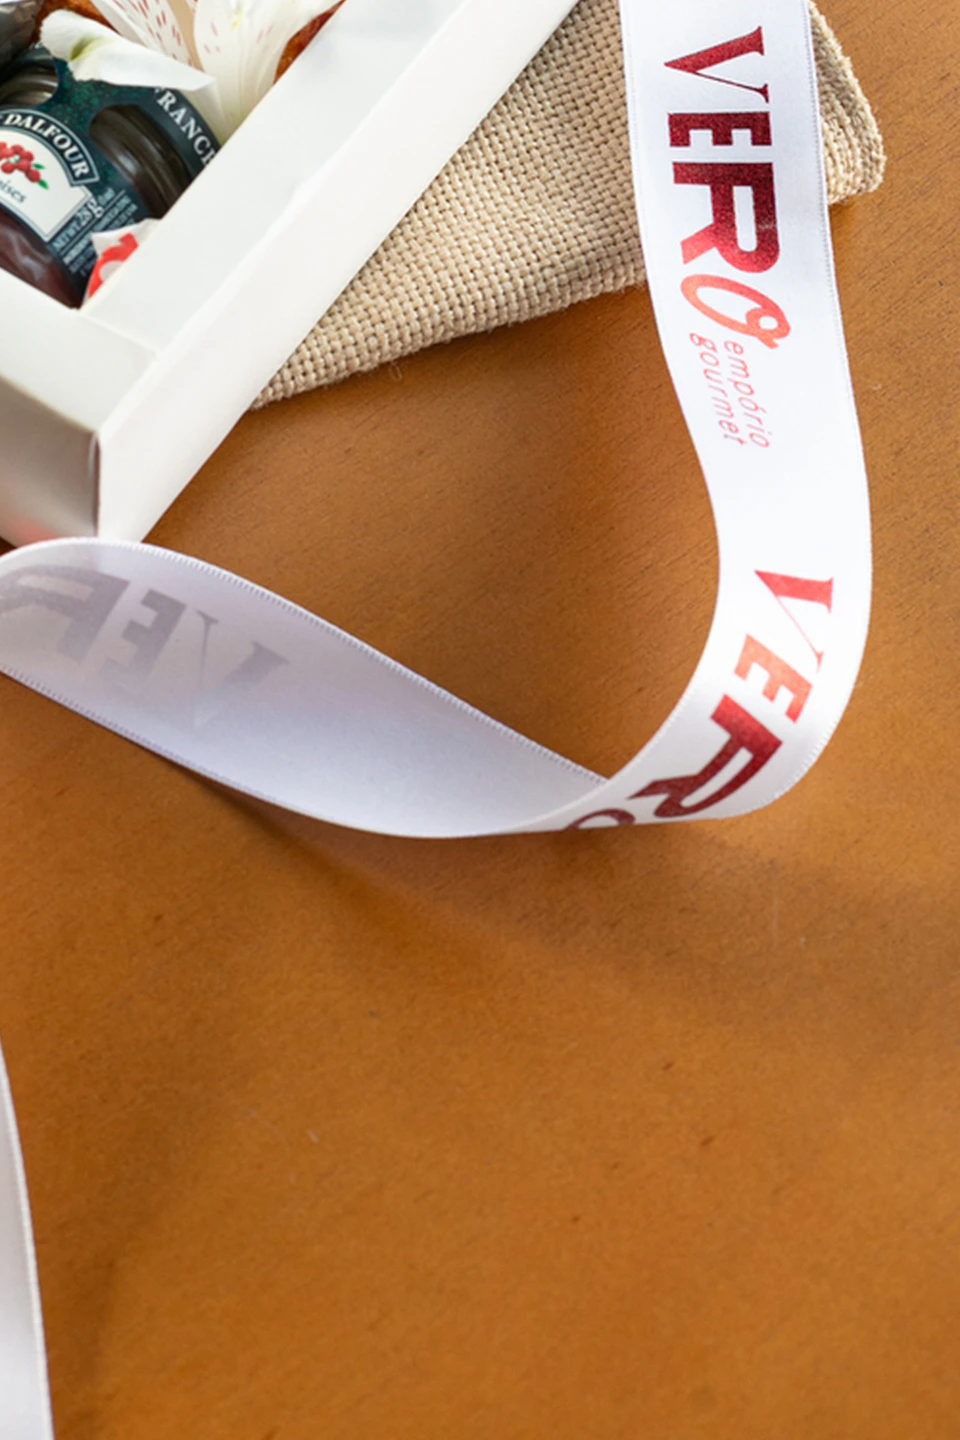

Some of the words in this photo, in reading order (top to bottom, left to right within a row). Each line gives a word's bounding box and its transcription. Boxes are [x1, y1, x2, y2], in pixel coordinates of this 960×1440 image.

[4, 113, 90, 178] DALFOUR
[663, 26, 791, 350] VERO
[689, 332, 744, 447] gourmet
[723, 339, 770, 449] empório
